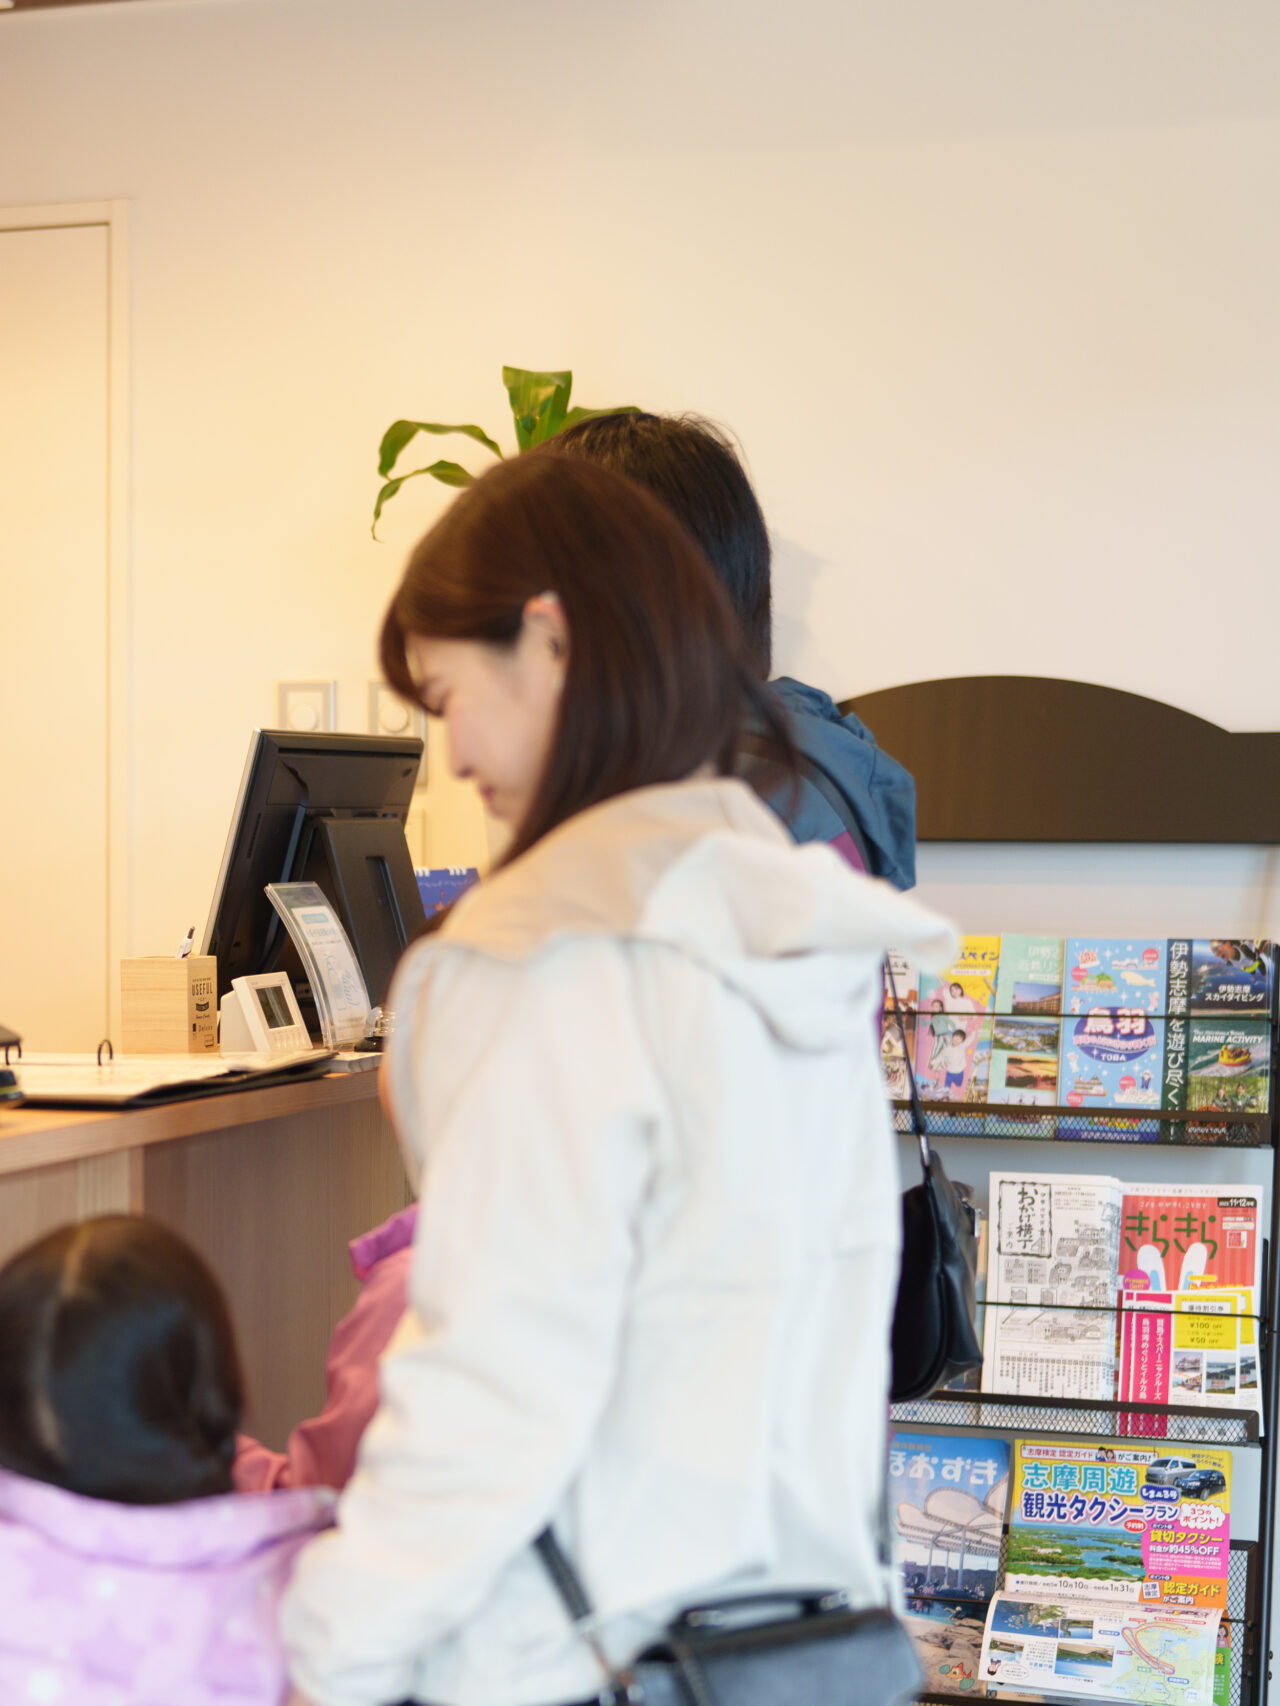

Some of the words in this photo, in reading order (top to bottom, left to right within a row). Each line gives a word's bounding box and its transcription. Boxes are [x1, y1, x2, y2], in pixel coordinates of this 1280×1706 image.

[192, 982, 213, 997] USEFUL
[1083, 1007, 1146, 1035] 鳥羽
[1166, 942, 1188, 1141] 伊勢志摩を遊び尽く!
[1192, 1034, 1225, 1043] MARINE
[1226, 1034, 1263, 1044] ACTIVITY
[1101, 1053, 1126, 1062] TOBA
[1016, 1186, 1038, 1250] おかげ横丁
[1124, 1210, 1218, 1260] きらきら
[1022, 1462, 1137, 1494] 志摩周遊
[1150, 1530, 1223, 1544] 貸切タクシー
[1163, 1582, 1220, 1597] 認定ガイド
